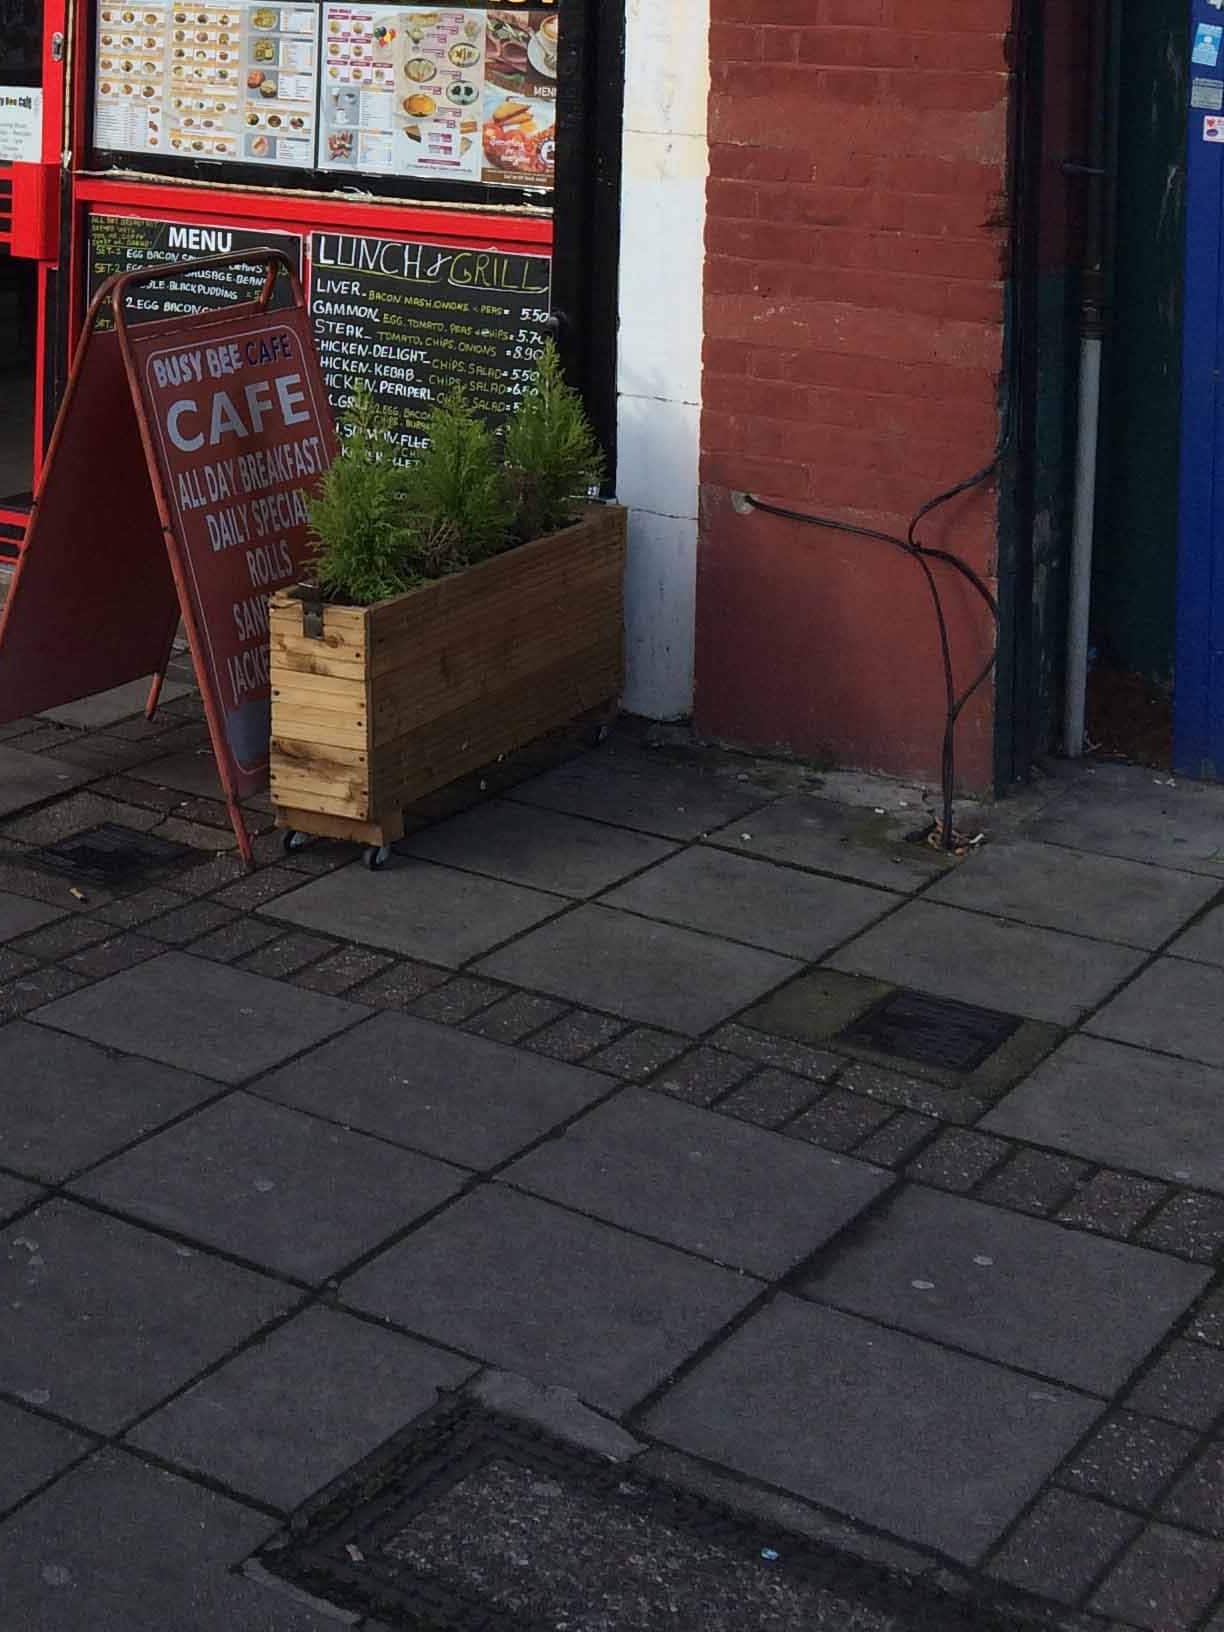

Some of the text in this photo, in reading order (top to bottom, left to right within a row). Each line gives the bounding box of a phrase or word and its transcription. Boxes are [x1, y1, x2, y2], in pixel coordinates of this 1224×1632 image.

[126, 248, 144, 259] EGG
[168, 227, 233, 252] MENU
[319, 236, 423, 279] LUNCH
[450, 253, 545, 290] GRILL
[136, 298, 160, 311] EGG
[152, 334, 293, 388] BUSY BEE CAFE
[166, 374, 311, 452] CAFE
[178, 471, 207, 511] ALL
[204, 461, 236, 502] DAY
[239, 436, 325, 493] BREAKFAST
[205, 488, 314, 552] DAILY SPECIAL
[247, 539, 294, 587] ROLLS
